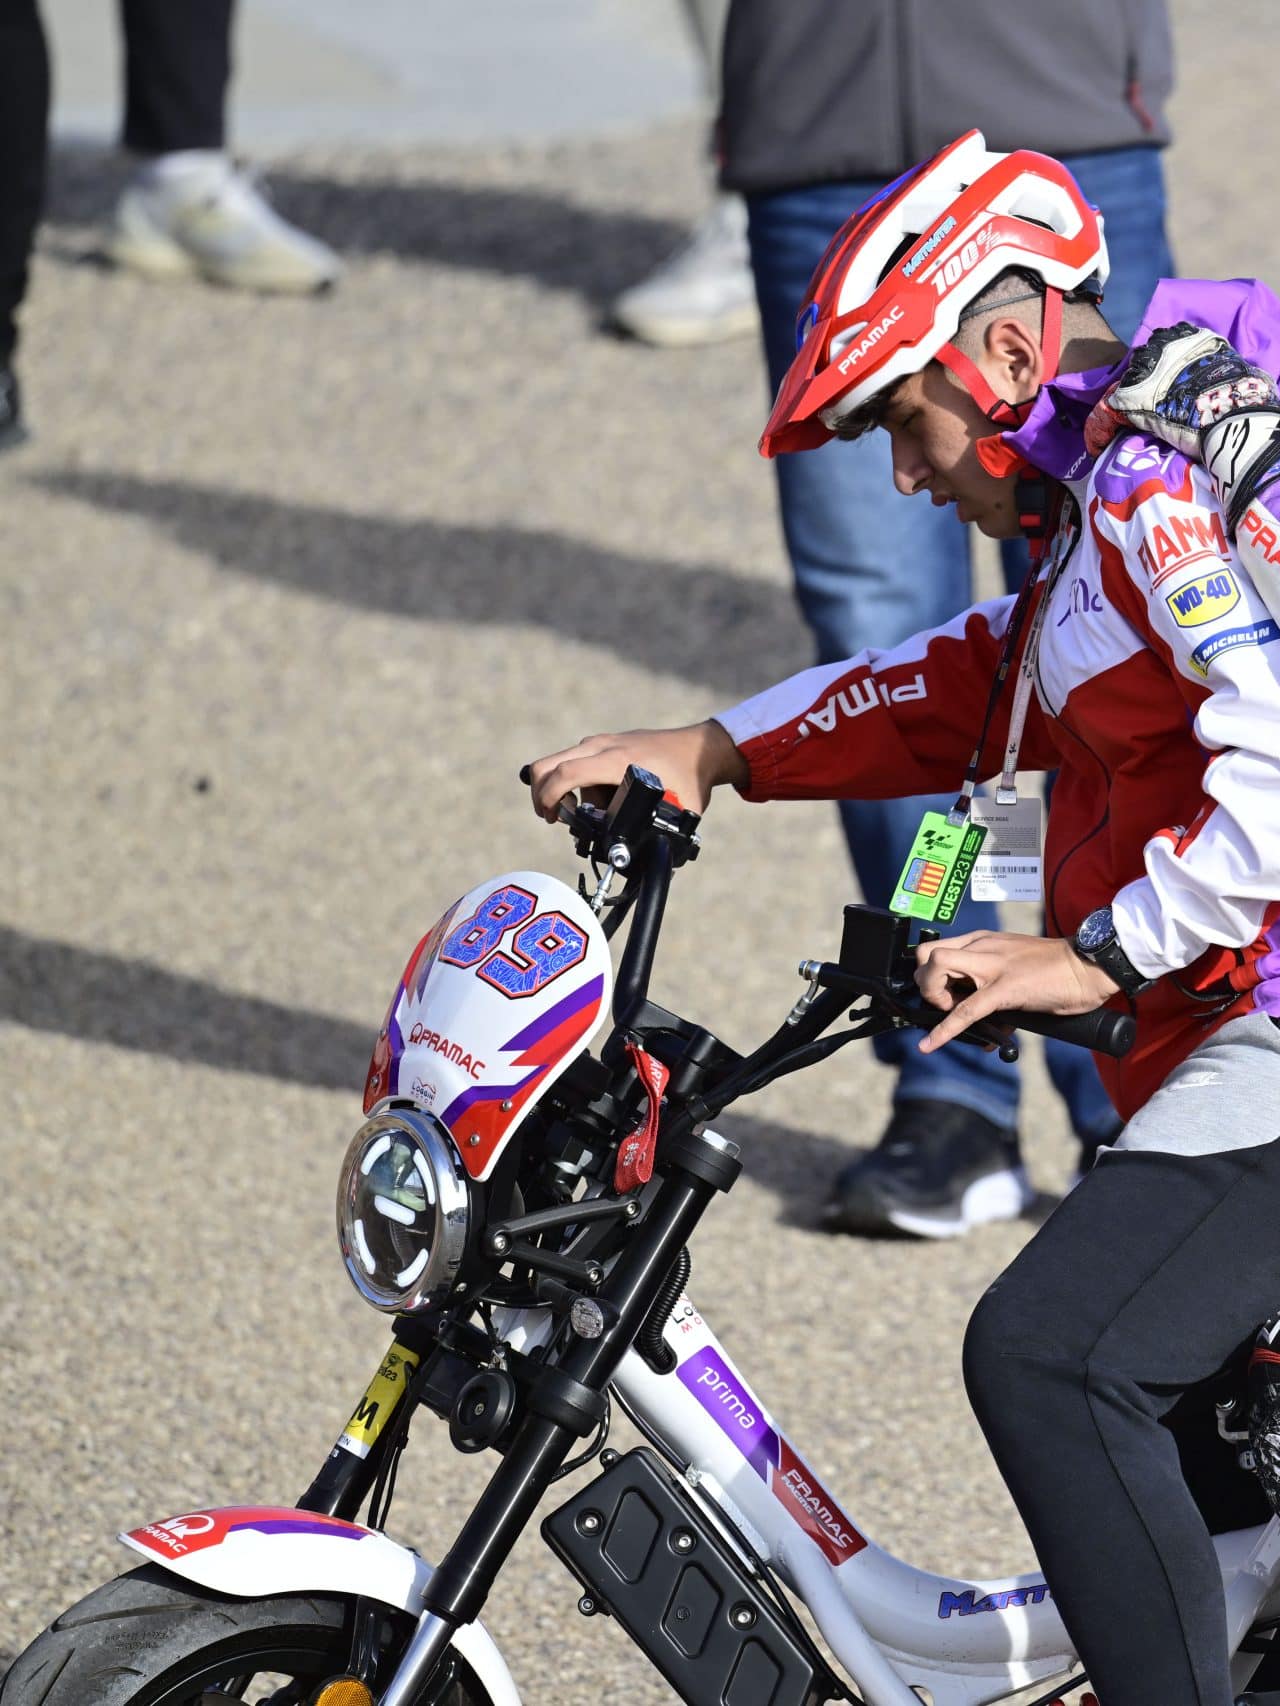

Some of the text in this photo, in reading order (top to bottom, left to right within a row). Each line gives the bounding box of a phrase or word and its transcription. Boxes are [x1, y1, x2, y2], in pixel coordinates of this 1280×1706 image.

[931, 222, 1001, 297] 100%
[838, 306, 905, 375] PRAMAC
[1172, 574, 1232, 617] WD-40
[1201, 626, 1270, 659] MICHELIN
[938, 860, 970, 920] GUEST23
[438, 884, 590, 1000] 89
[419, 1028, 486, 1080] PRAMAC
[697, 1366, 756, 1429] prima
[786, 1468, 853, 1548] PRAMAC
